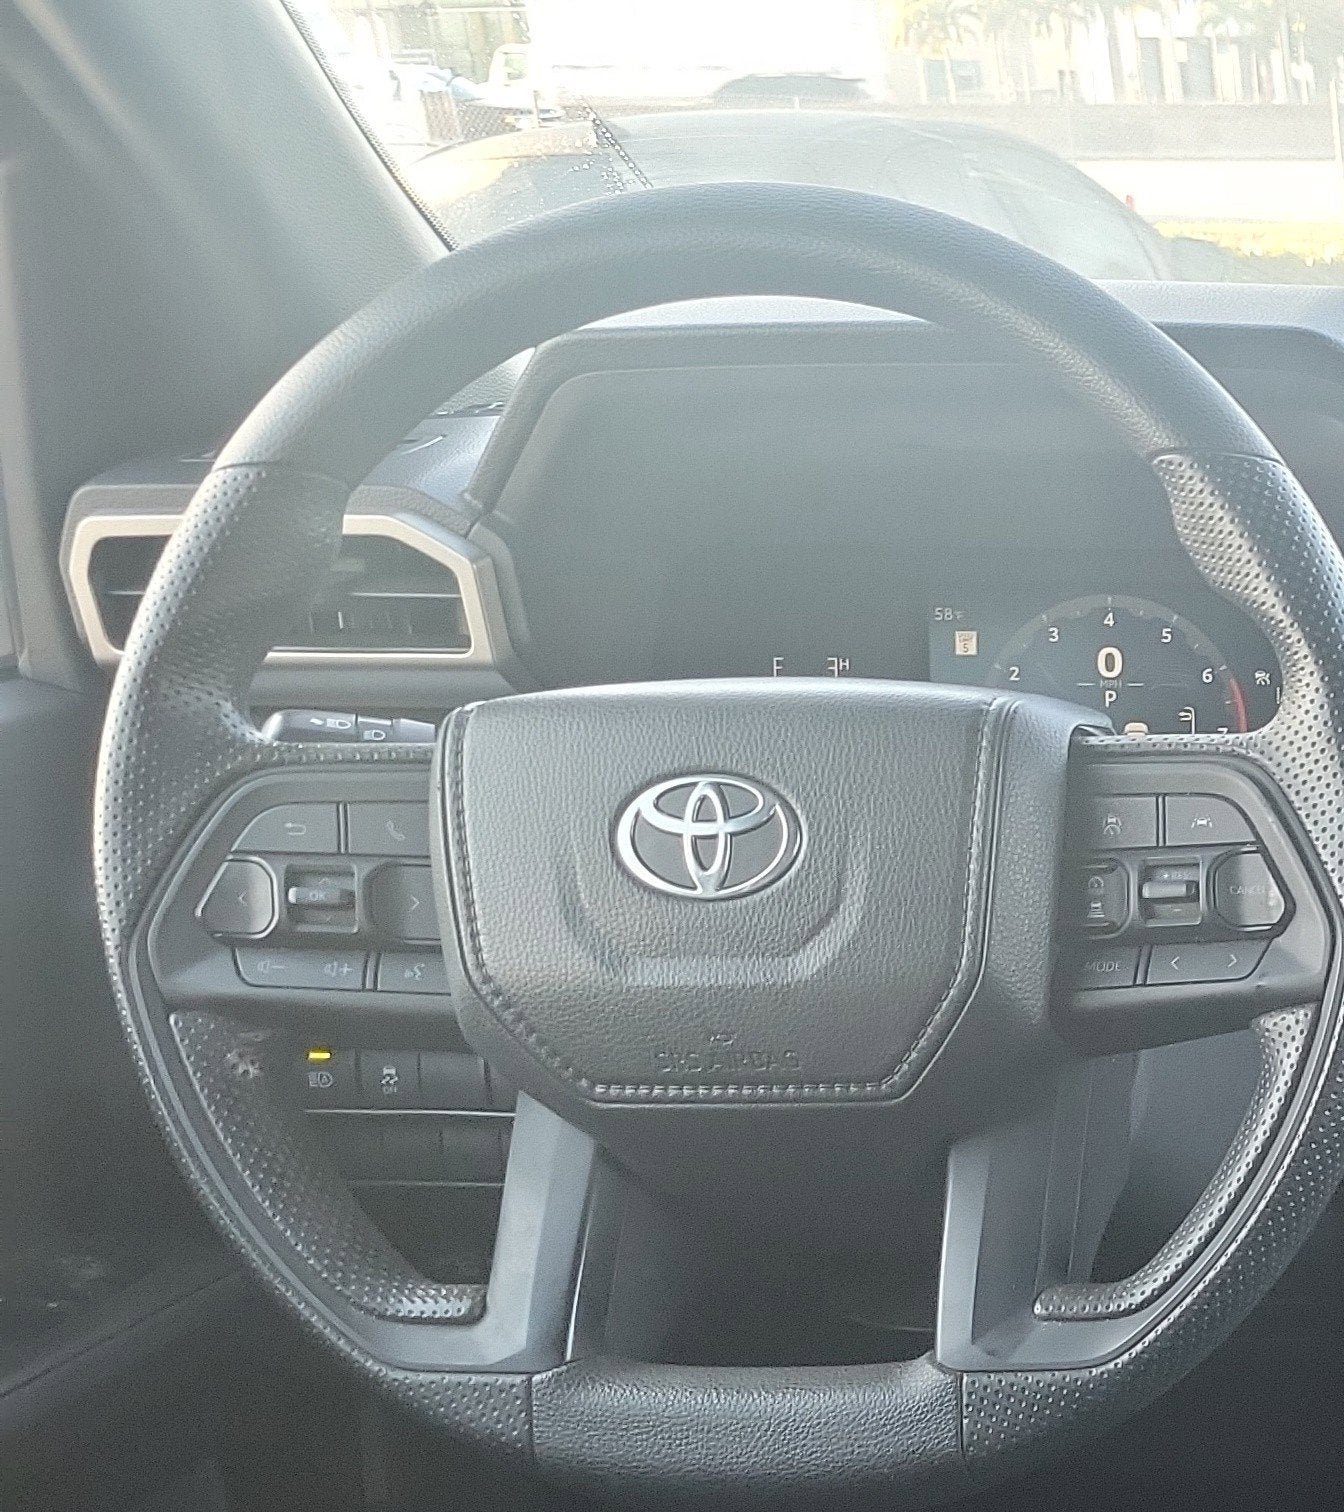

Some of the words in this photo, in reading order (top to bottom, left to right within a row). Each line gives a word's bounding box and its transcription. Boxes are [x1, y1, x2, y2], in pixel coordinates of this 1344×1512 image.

[1103, 612, 1115, 627] 4
[1048, 627, 1060, 642] 3
[1160, 628, 1172, 643] 5
[1097, 646, 1123, 678] 0
[1008, 666, 1021, 682] 2
[1201, 668, 1213, 683] 6
[1104, 690, 1117, 708] P
